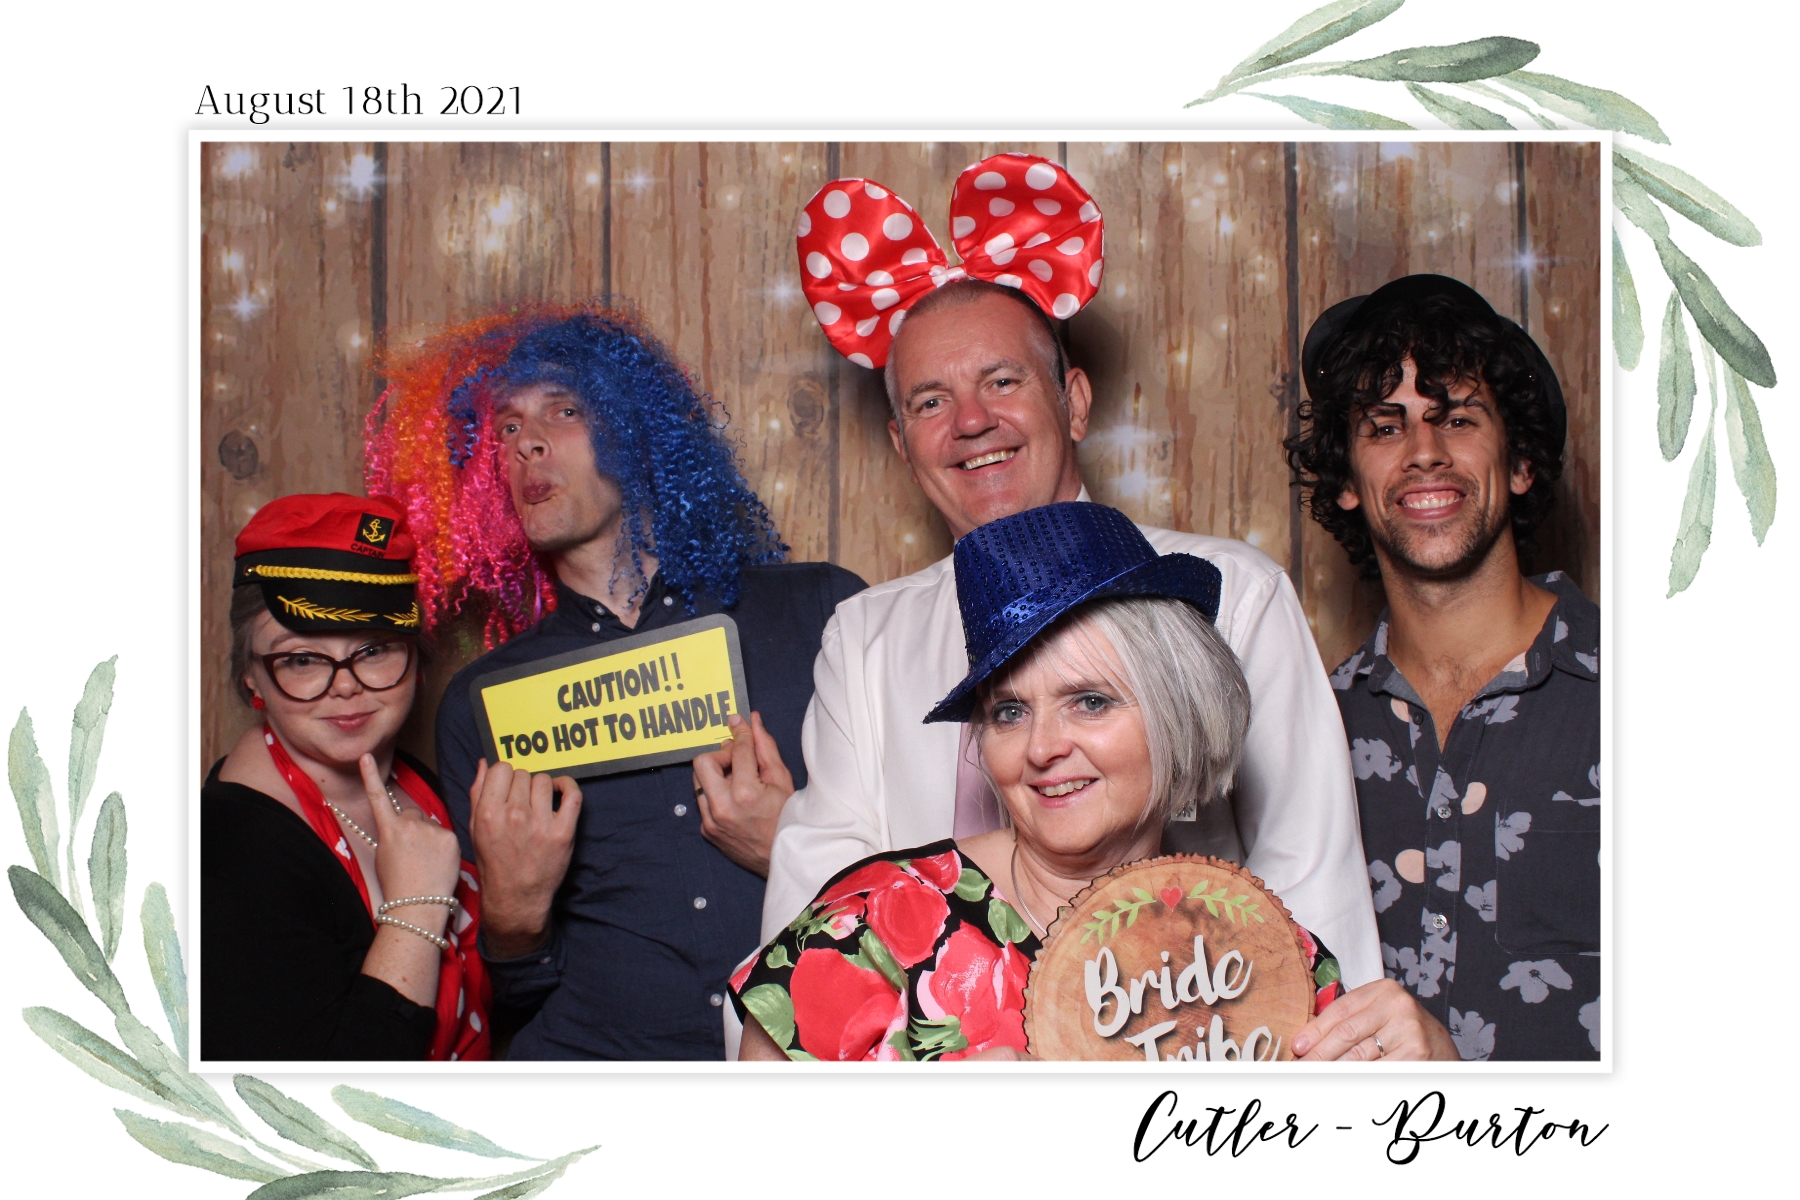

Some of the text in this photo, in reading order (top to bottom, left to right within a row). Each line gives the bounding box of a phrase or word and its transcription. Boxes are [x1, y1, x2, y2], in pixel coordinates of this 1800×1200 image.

[350, 543, 385, 559] CAPTAIN
[557, 652, 684, 712] CAUTION!!
[500, 690, 731, 759] TOO HOT TO HANDLE
[1084, 934, 1253, 1038] Bride
